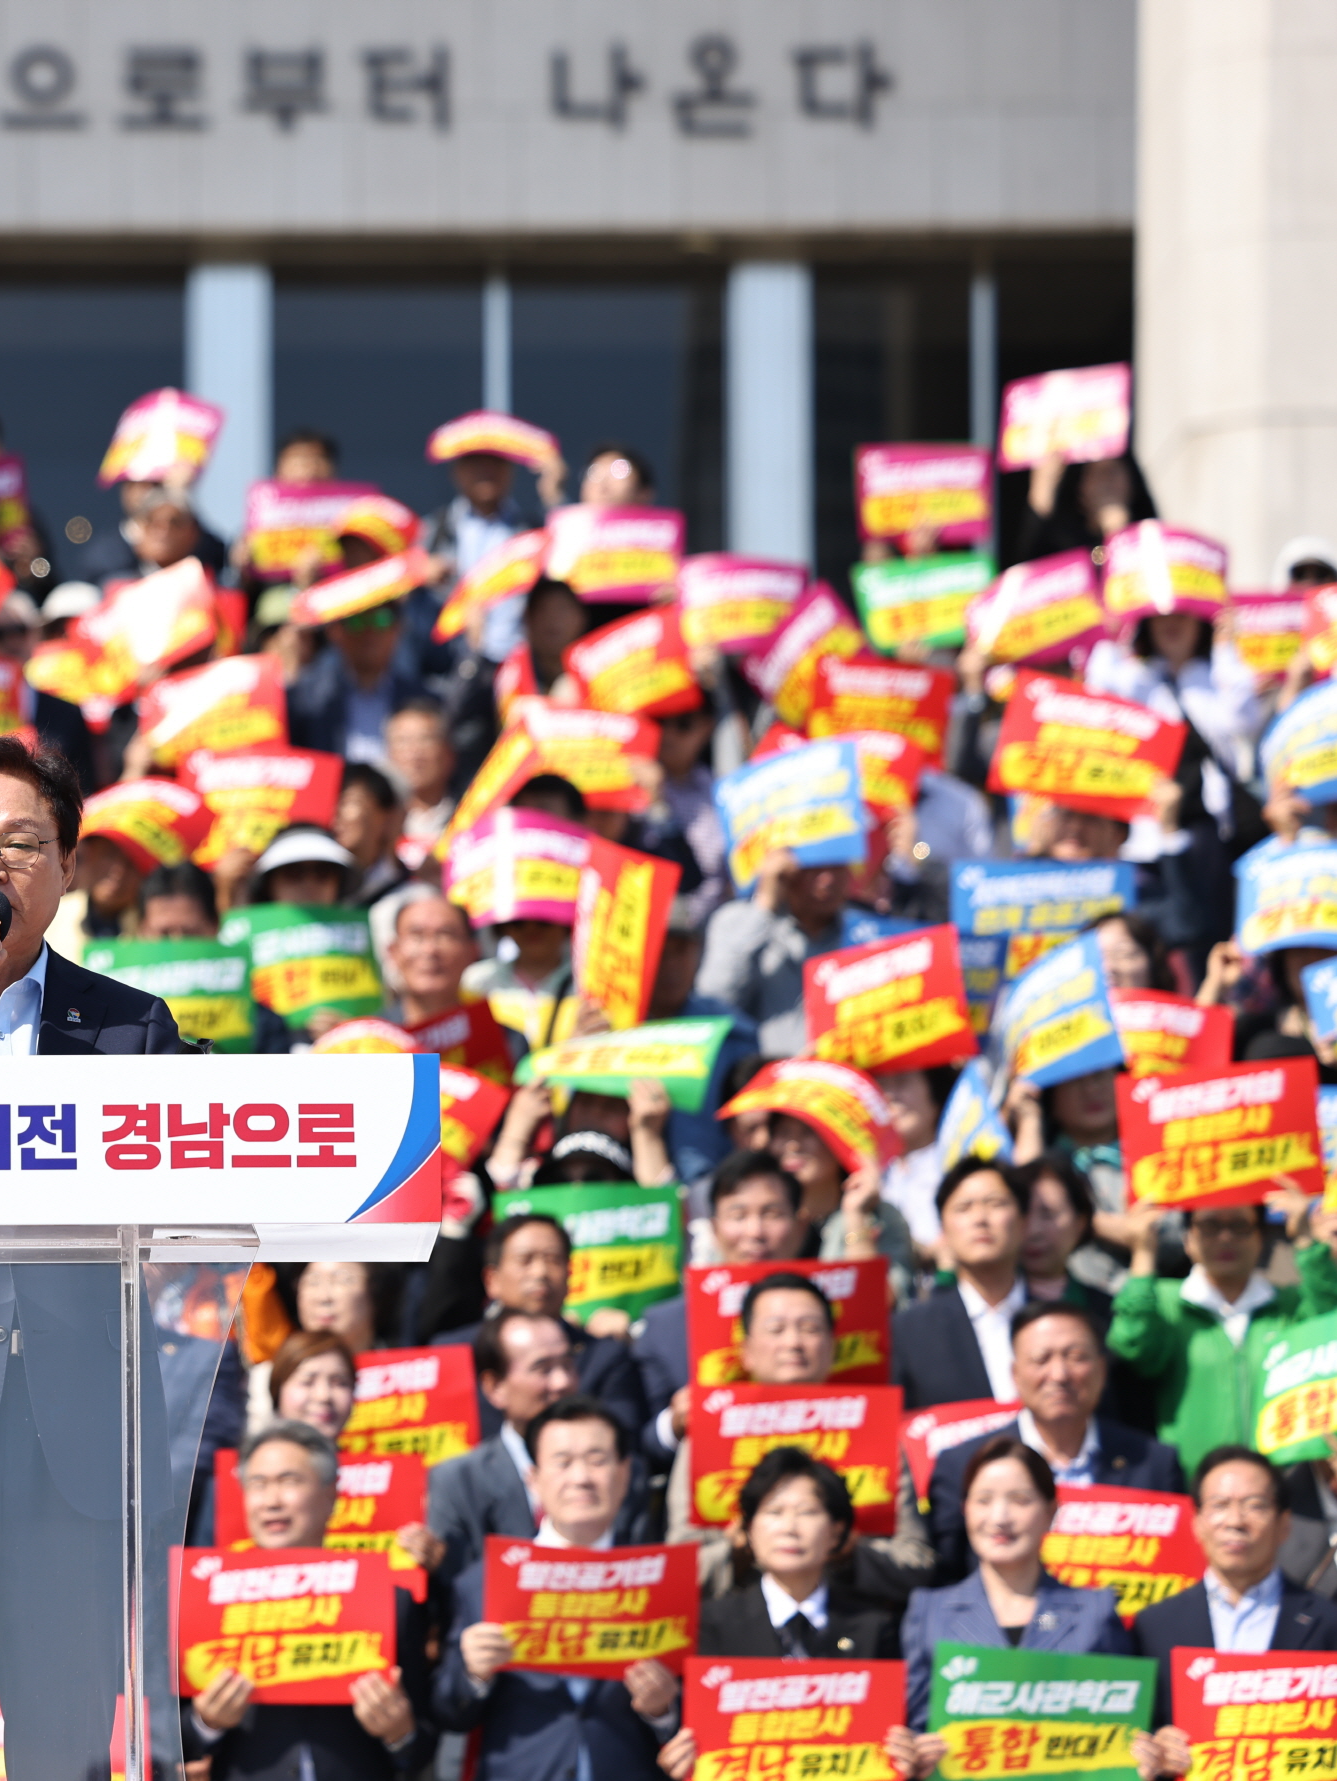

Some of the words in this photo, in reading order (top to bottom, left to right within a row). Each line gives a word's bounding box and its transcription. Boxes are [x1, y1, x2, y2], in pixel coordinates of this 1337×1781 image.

[548, 32, 896, 144] 나온다
[102, 1101, 357, 1171] 경남으로
[290, 1637, 361, 1669] 유치!
[597, 1622, 667, 1652] 유치!
[945, 1679, 1141, 1715] 해군사관학교
[1214, 1698, 1337, 1738] 통합본사
[799, 1745, 870, 1778] 유치!
[953, 1722, 1041, 1772] 통합
[1043, 1724, 1119, 1761] 반대!
